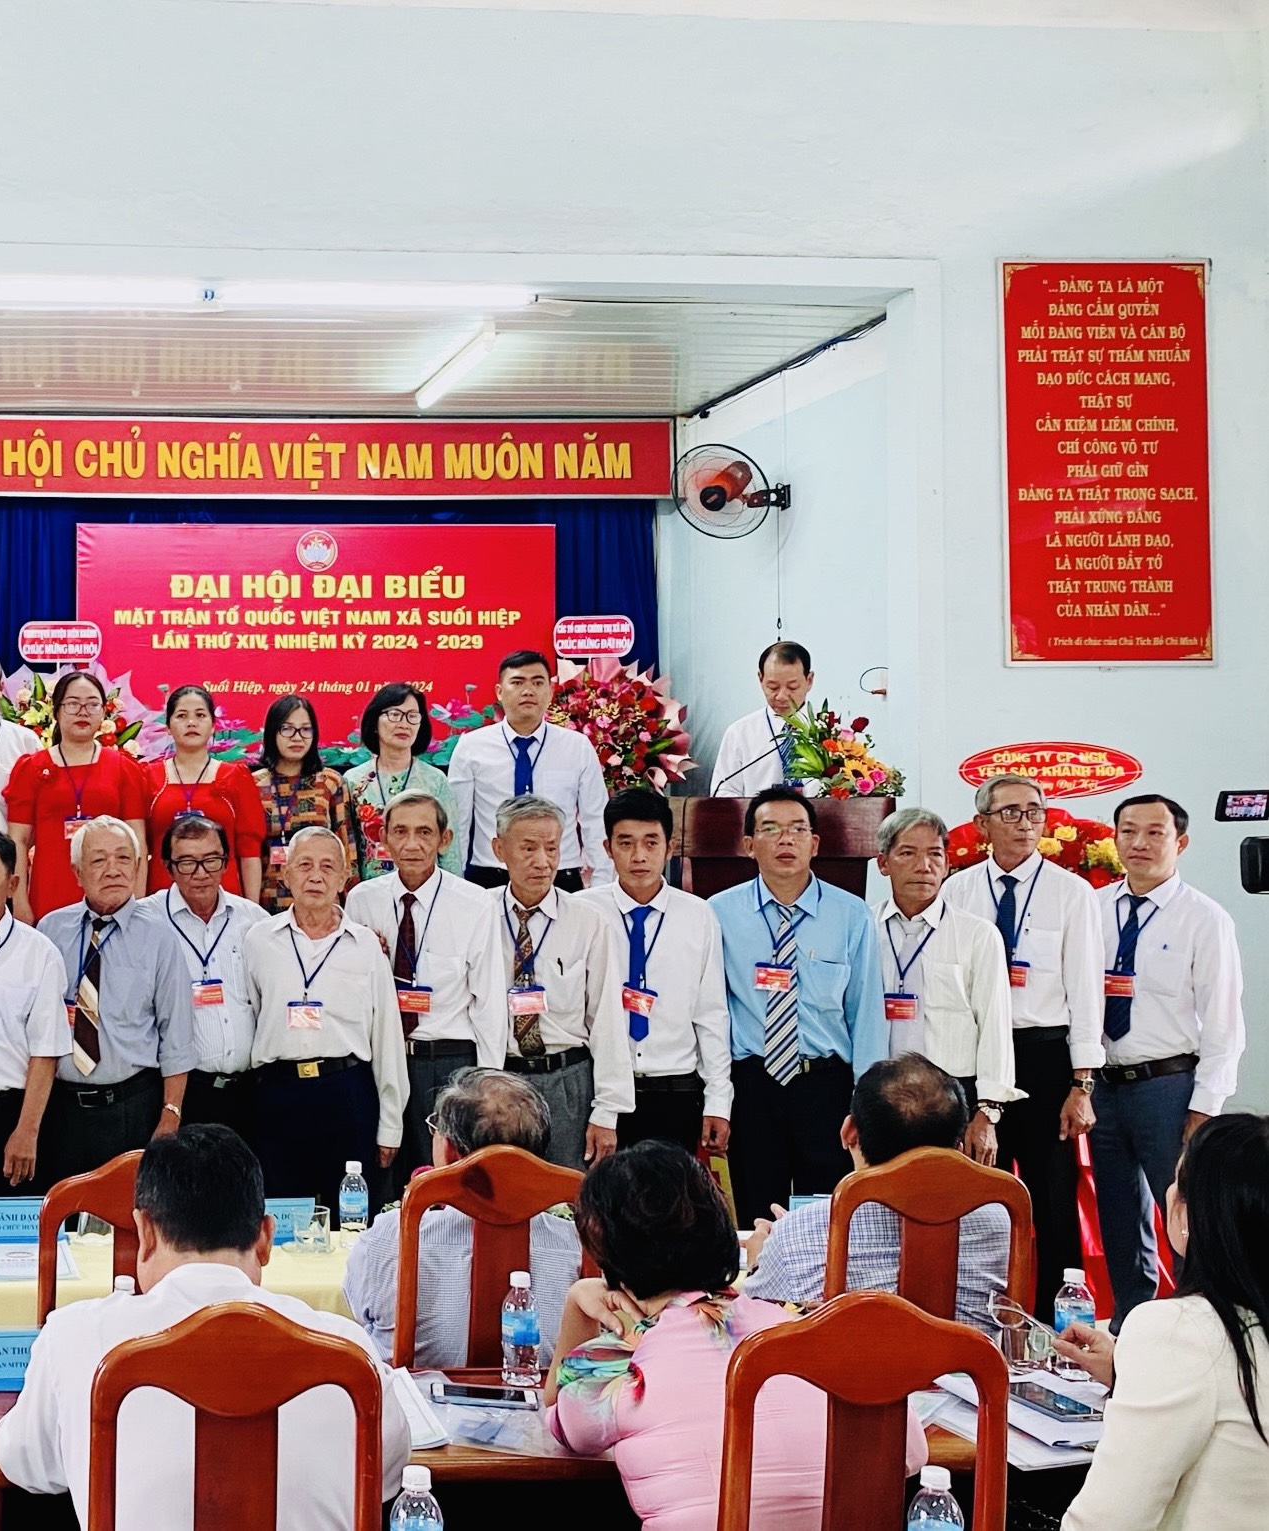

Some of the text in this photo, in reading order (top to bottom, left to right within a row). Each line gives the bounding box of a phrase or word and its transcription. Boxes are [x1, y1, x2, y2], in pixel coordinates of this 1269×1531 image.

[1098, 281, 1113, 292] TA
[1118, 277, 1133, 293] LÀ
[1138, 278, 1164, 295] MỘT
[1049, 296, 1159, 320] ĐẢNG CẦM QUYỀN
[1021, 320, 1185, 342] MỖI ĐẢNG VIÊN VÀ CÁN BỘ
[1018, 343, 1190, 365] PHẢI THẬT SỰ THẤM NHUẦN
[1037, 372, 1062, 388] ĐẠO
[1067, 369, 1093, 385] ĐỨC
[1096, 369, 1130, 385] CÁCH
[1079, 393, 1133, 411] THẬT SỰ
[4, 429, 61, 487] HỘI
[75, 427, 145, 478] CHỦ
[158, 432, 262, 480] NGHĨA
[270, 433, 346, 490] VIỆT
[357, 442, 432, 480] NAM
[444, 432, 543, 480] MUÔN
[555, 432, 631, 480] NĂM
[1067, 460, 1148, 477] PHẢI GIỮ GÌN
[170, 565, 466, 603] ĐẠI HỘI ĐẠI BIỂU
[114, 604, 521, 629] MẶT TRẬN TỔ QUỐC VIỆT NAM XÃ SUỐI HIỆP
[152, 629, 190, 649] LẦN
[194, 629, 232, 649] THỨ
[235, 634, 269, 652] XIV,
[275, 631, 337, 653] NHIỆM
[342, 630, 367, 649] KỲ
[371, 634, 419, 649] 2024
[437, 634, 483, 649] 2029
[202, 679, 229, 692] Suối
[233, 680, 265, 695] Hiệp,
[269, 682, 296, 695] ngày
[300, 681, 314, 692] 24
[318, 681, 352, 695] tháng
[356, 681, 370, 692] 01
[993, 751, 1030, 763] CÔNG
[1036, 752, 1051, 762] TY
